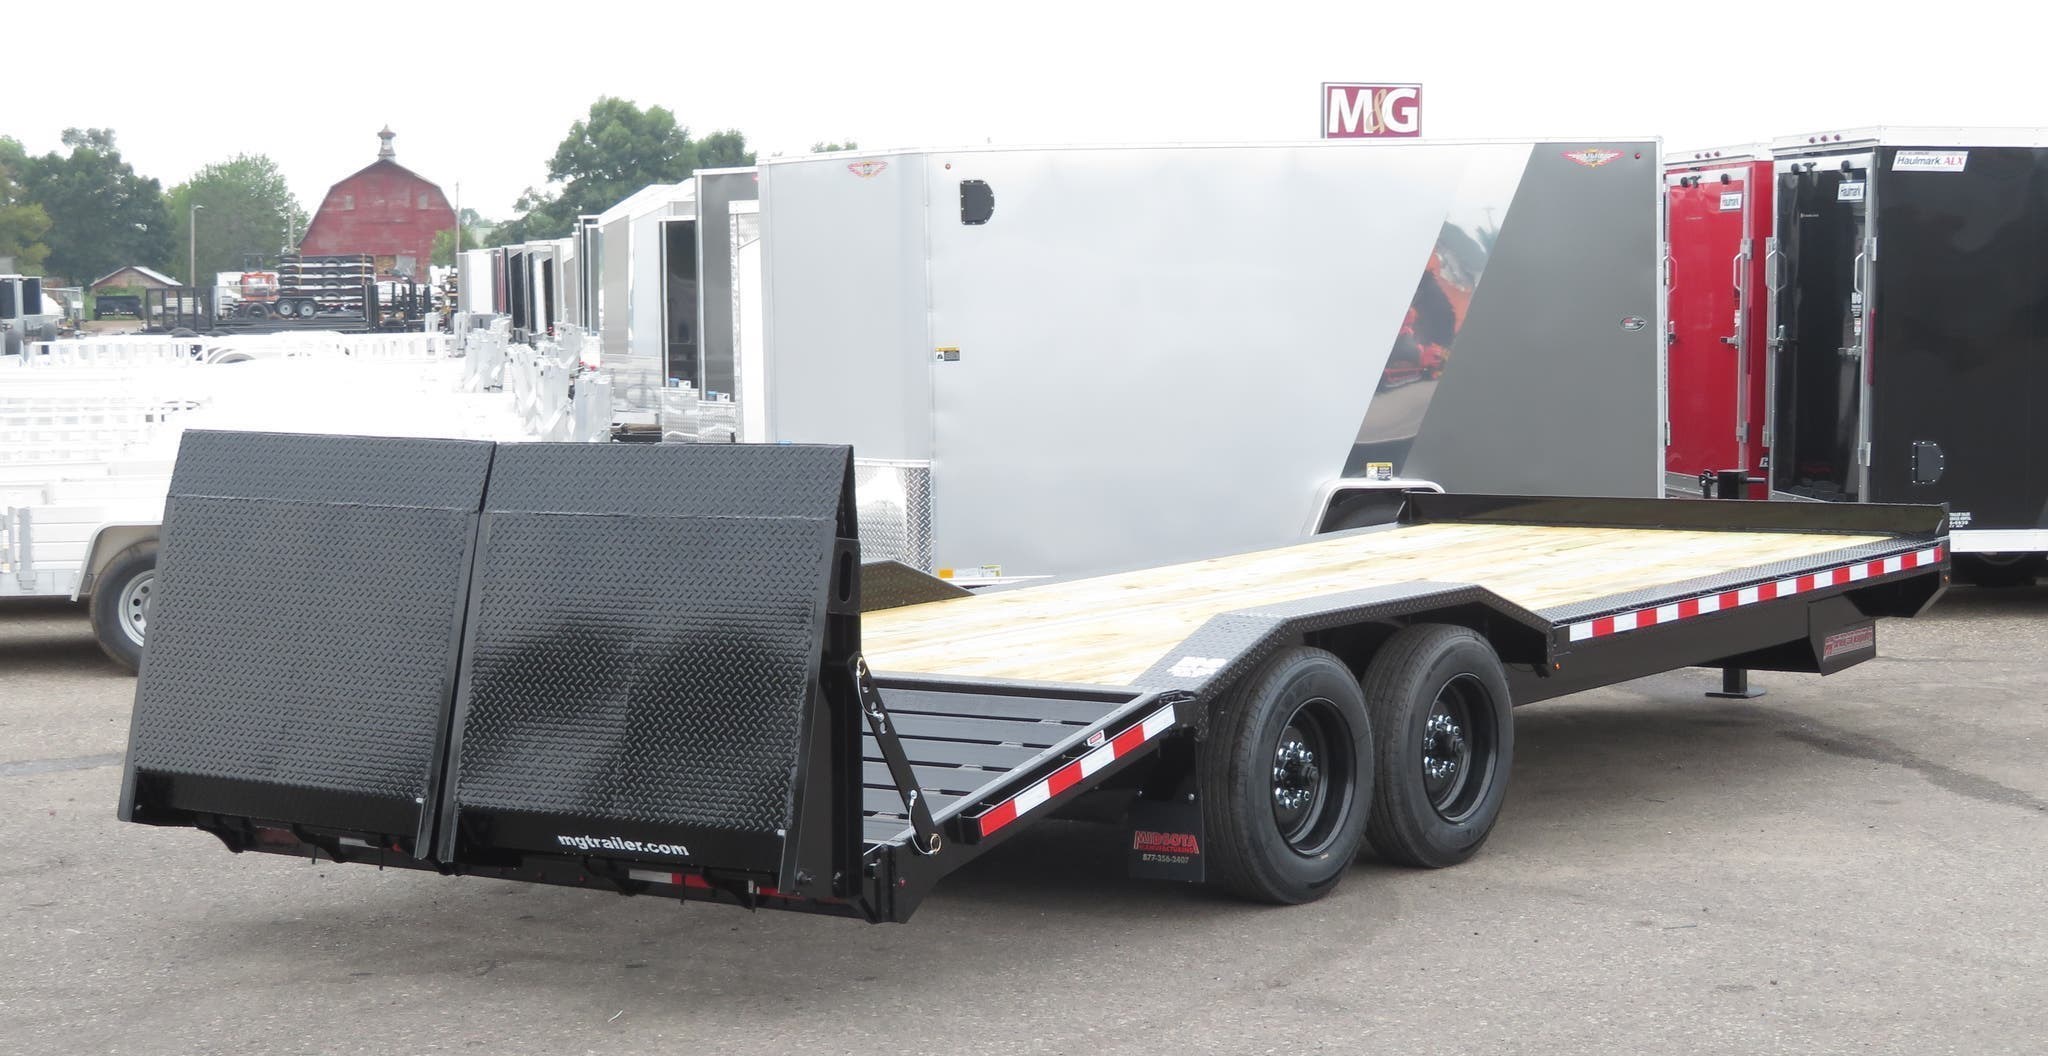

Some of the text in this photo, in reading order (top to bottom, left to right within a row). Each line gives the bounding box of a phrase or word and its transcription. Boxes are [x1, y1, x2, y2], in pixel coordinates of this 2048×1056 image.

[1328, 88, 1419, 134] M&G
[1897, 156, 1964, 166] Haulmark ALX
[557, 834, 690, 856] mgtrailer.com
[1133, 830, 1200, 854] MIDSOTA
